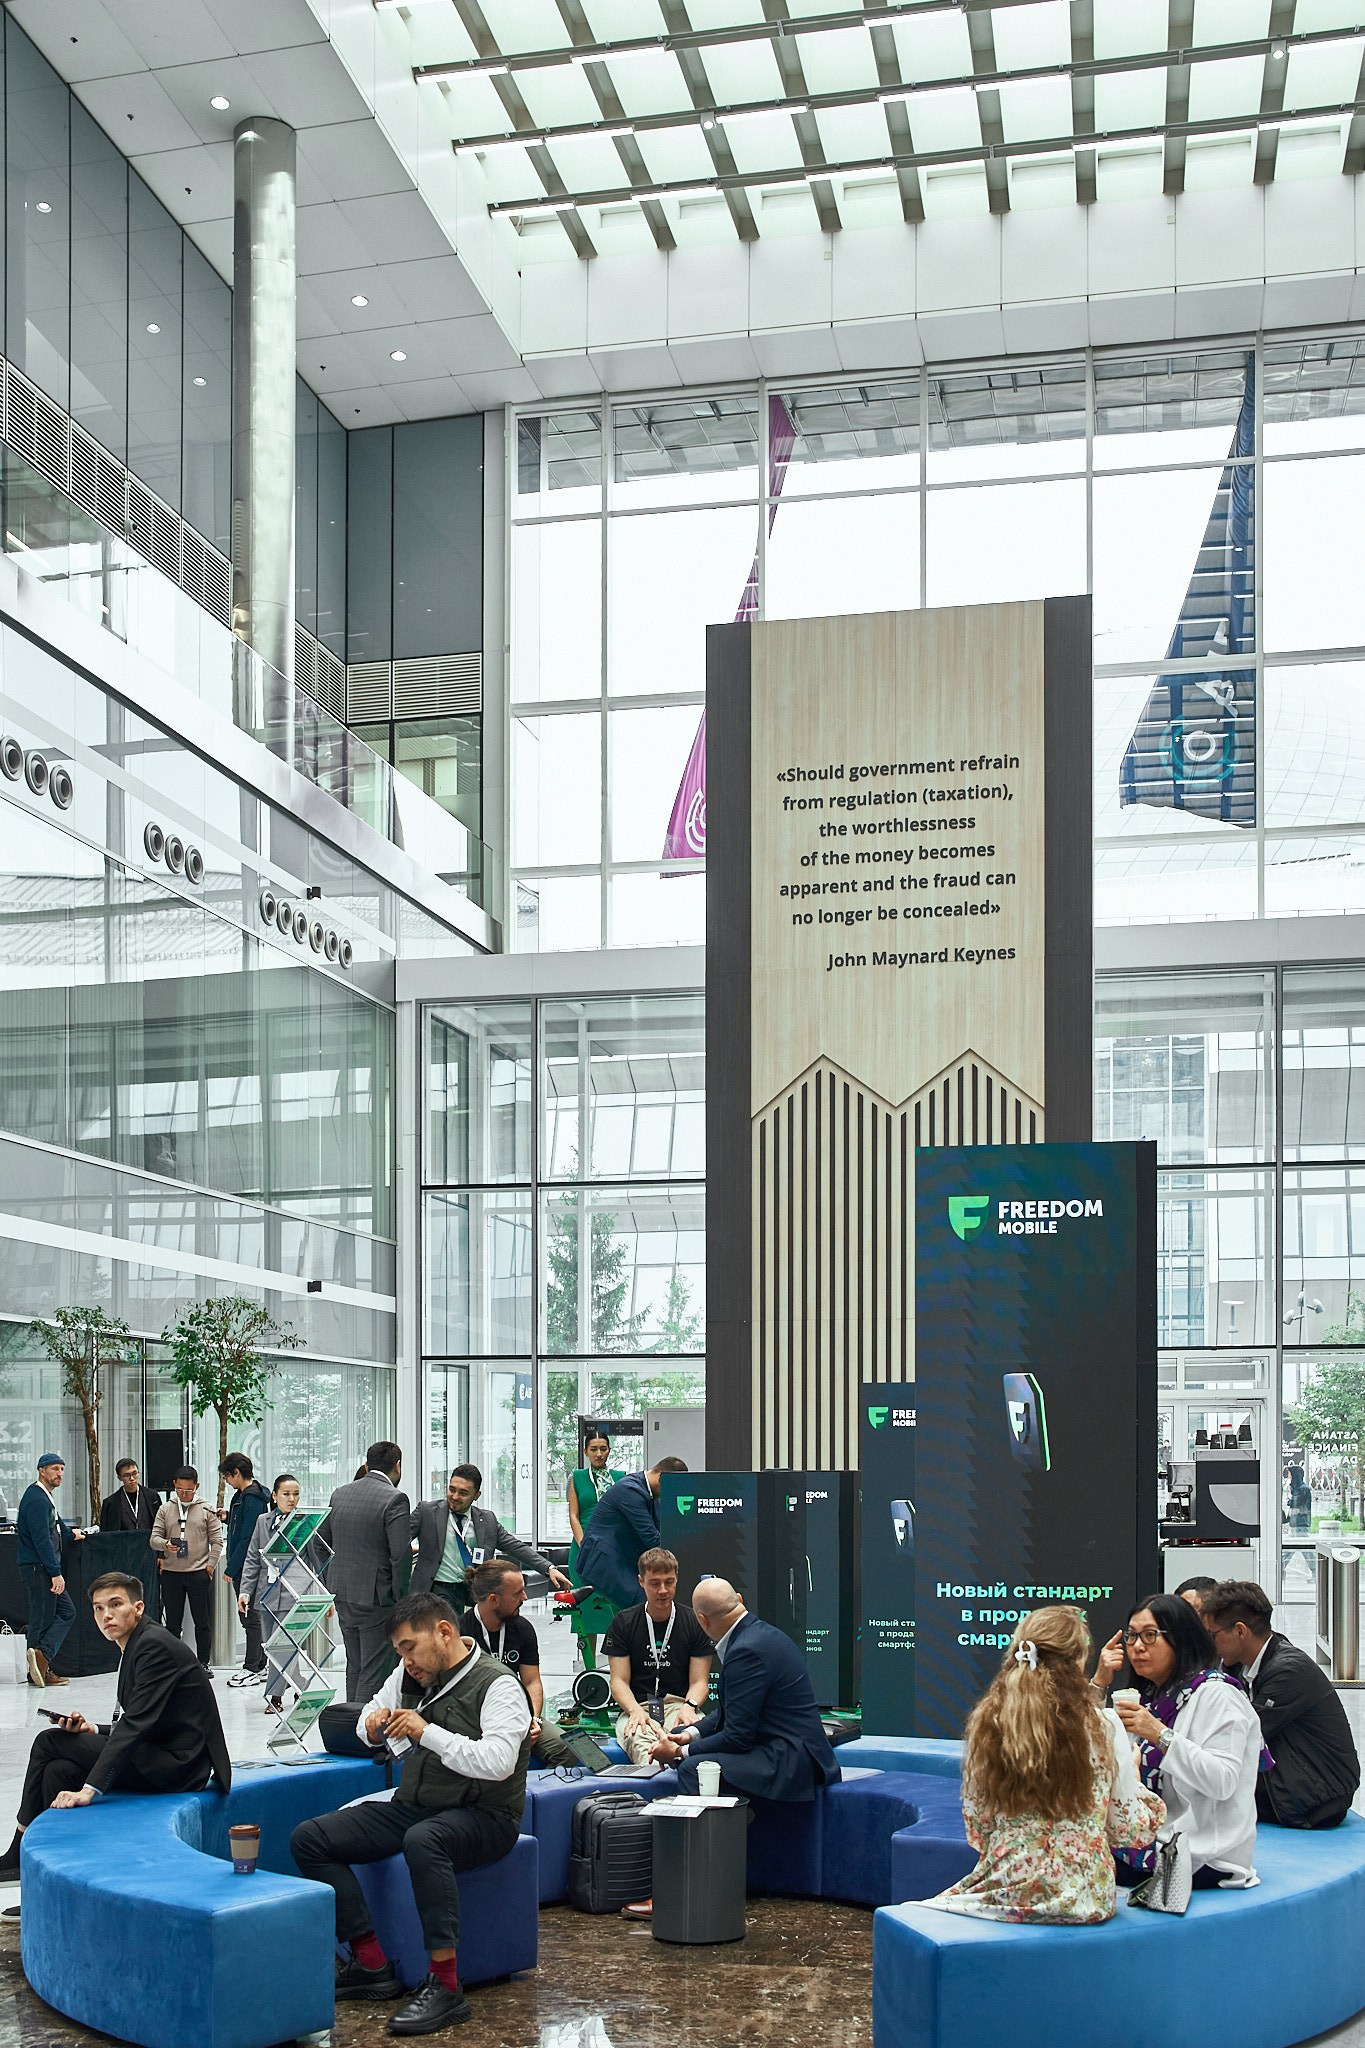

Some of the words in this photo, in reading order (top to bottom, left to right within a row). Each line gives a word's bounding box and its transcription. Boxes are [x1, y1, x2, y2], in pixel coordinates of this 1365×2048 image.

[776, 764, 844, 782] «Should
[849, 758, 955, 782] government
[960, 753, 1020, 772] refrain
[782, 796, 824, 811] from
[829, 789, 917, 811] regulation
[922, 783, 1014, 804] (taxation),
[818, 821, 848, 837] the
[852, 816, 976, 835] worthlessness
[800, 851, 818, 867] of
[821, 850, 850, 866] the
[855, 849, 914, 865] money
[918, 844, 996, 861] becomes
[779, 879, 858, 899] apparent
[862, 875, 895, 892] and
[899, 874, 929, 890] the
[933, 871, 981, 888] fraud
[985, 873, 1016, 886] can
[792, 913, 814, 926] no
[818, 908, 873, 926] longer
[877, 905, 898, 921] be
[902, 899, 1001, 918] concealed»
[827, 953, 867, 971] John
[872, 947, 948, 968] Maynard
[954, 946, 1016, 965] Keynes
[998, 1199, 1104, 1219] FREEDOM
[998, 1221, 1058, 1235] MOBILE
[892, 1409, 916, 1419] FREE
[697, 1498, 743, 1507] FREEDOM
[806, 1491, 828, 1499] EDOM
[936, 1582, 1007, 1598] Новый
[1013, 1586, 1113, 1601] стандарт
[868, 1619, 899, 1627] Новый
[961, 1609, 973, 1622] в
[806, 1629, 829, 1638] ндарт
[878, 1641, 915, 1649] смартфо
